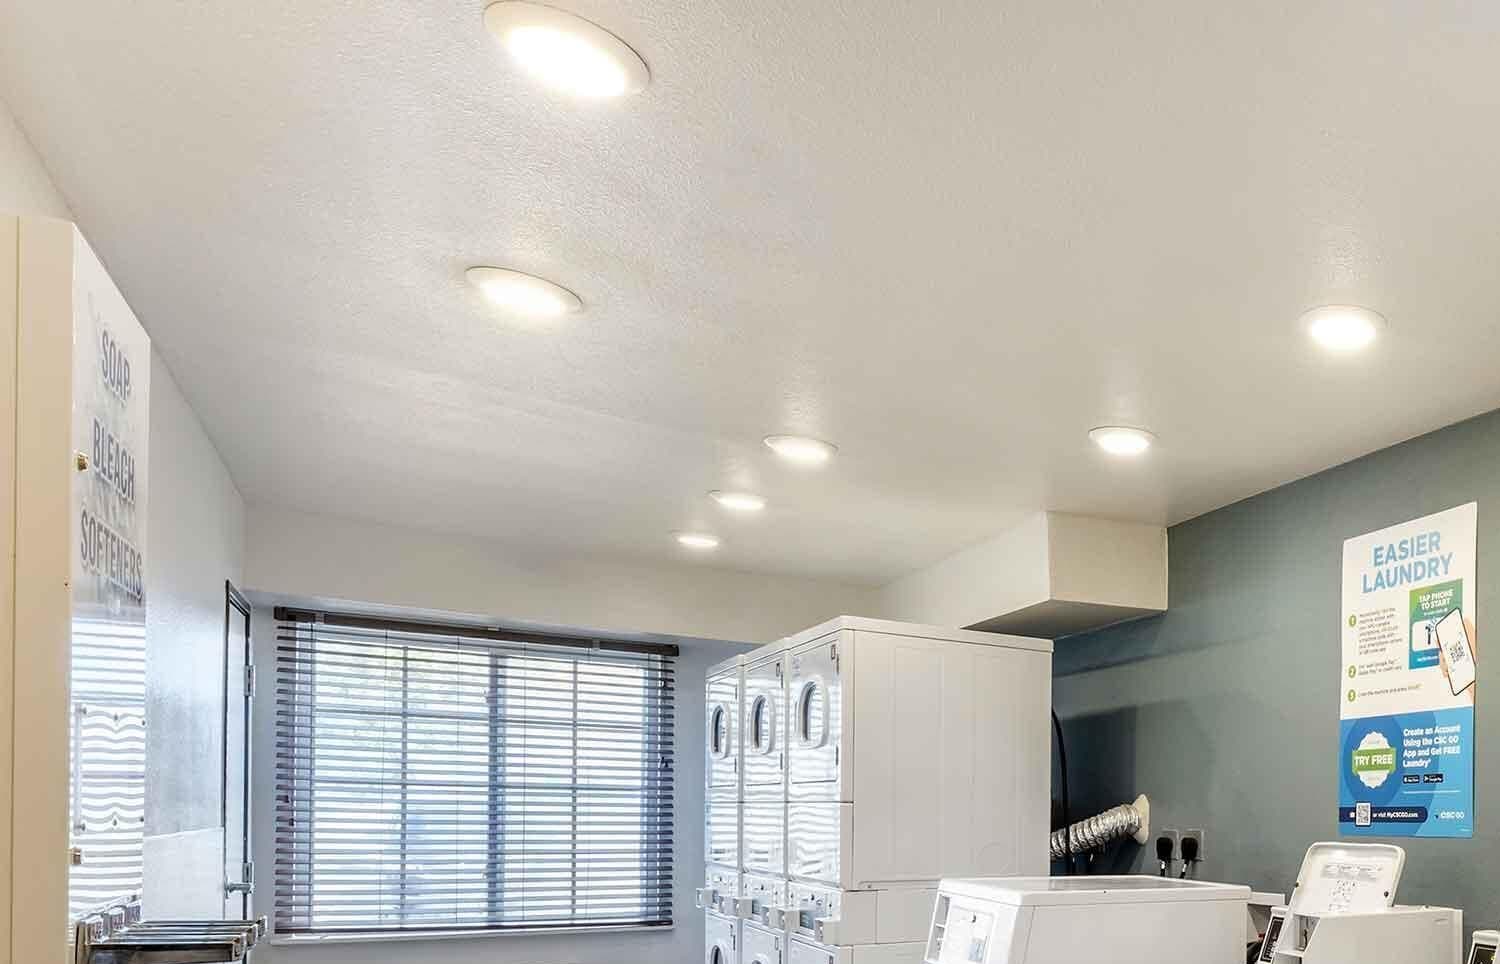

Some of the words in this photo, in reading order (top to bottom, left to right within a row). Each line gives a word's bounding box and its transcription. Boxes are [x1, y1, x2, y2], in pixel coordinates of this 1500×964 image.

[102, 330, 130, 400] SOAP
[93, 418, 135, 501] BLEACH
[81, 509, 142, 596] SOFTENERS
[1362, 552, 1453, 593] LAUNDRY
[1373, 531, 1441, 567] EASIER
[1354, 755, 1369, 766] TRY
[1371, 754, 1393, 766] FREE
